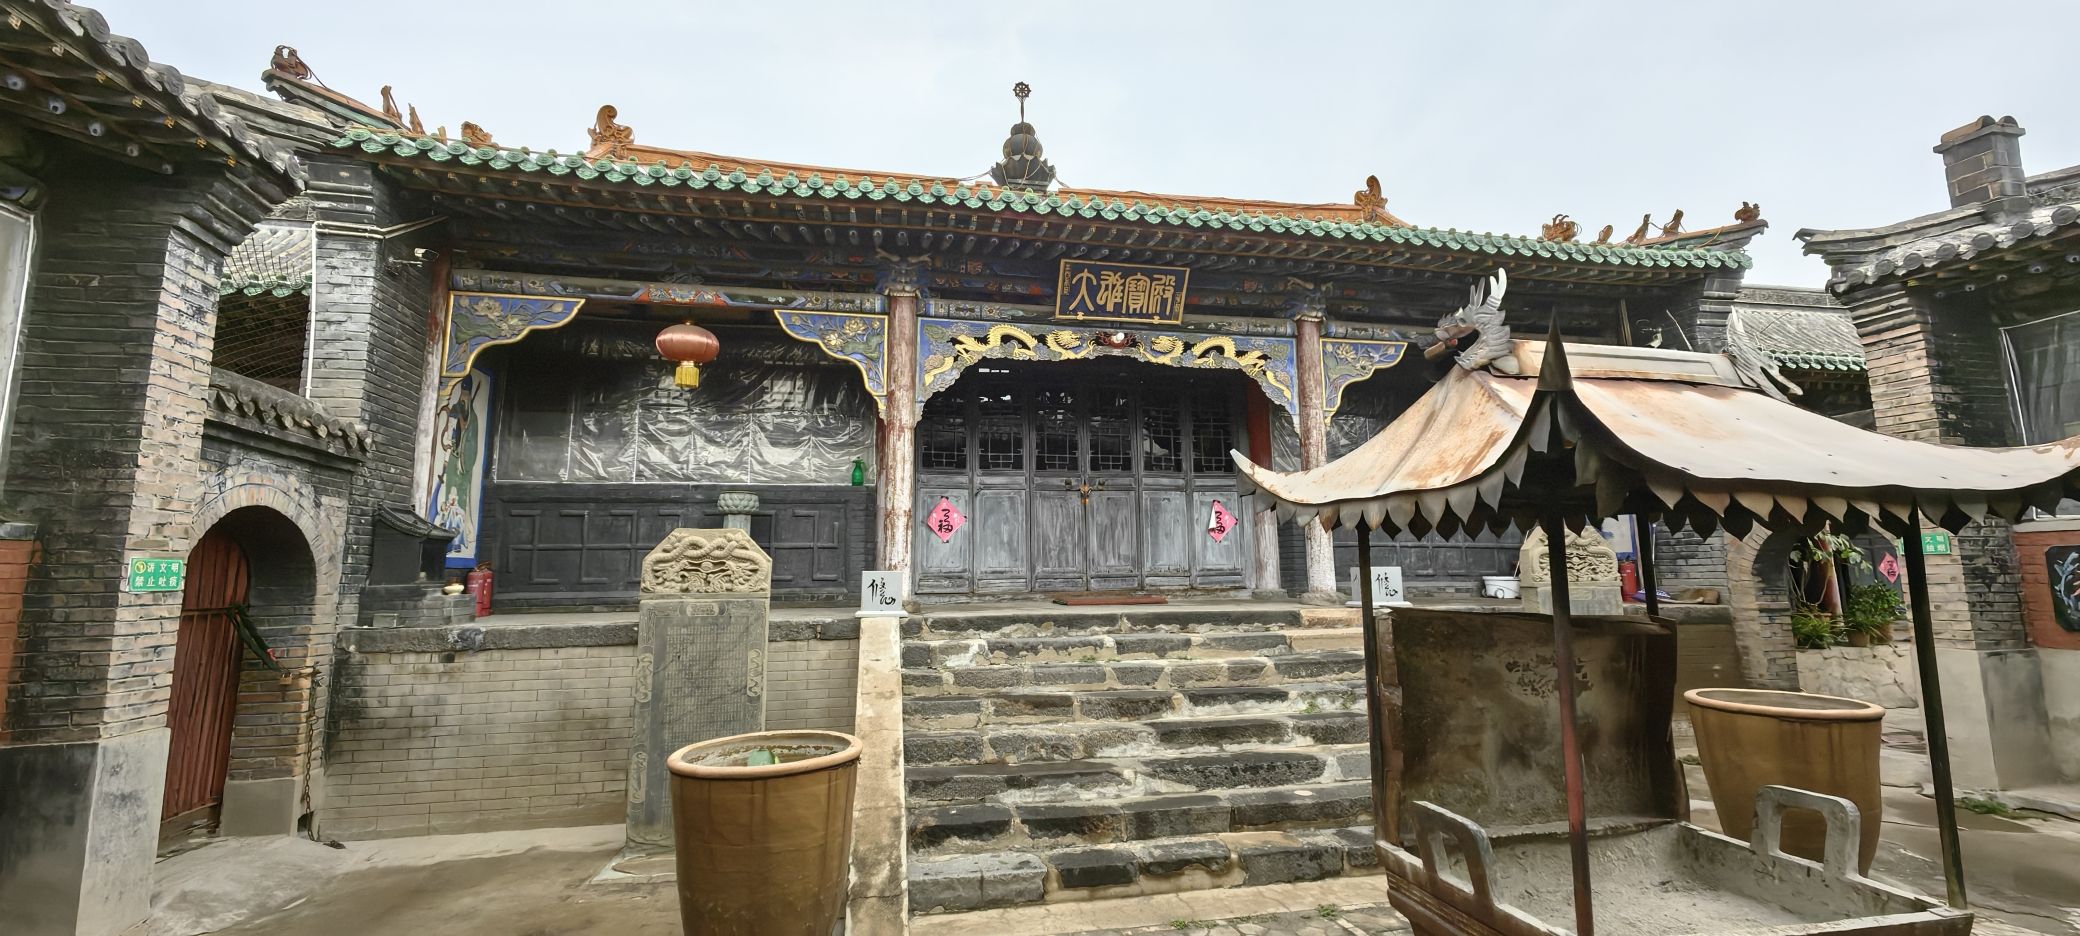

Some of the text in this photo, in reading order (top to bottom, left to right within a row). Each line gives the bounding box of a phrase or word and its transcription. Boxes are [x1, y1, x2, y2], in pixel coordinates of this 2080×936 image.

[146, 562, 179, 573] 讲文明
[134, 576, 178, 587] 禁止吐痰
